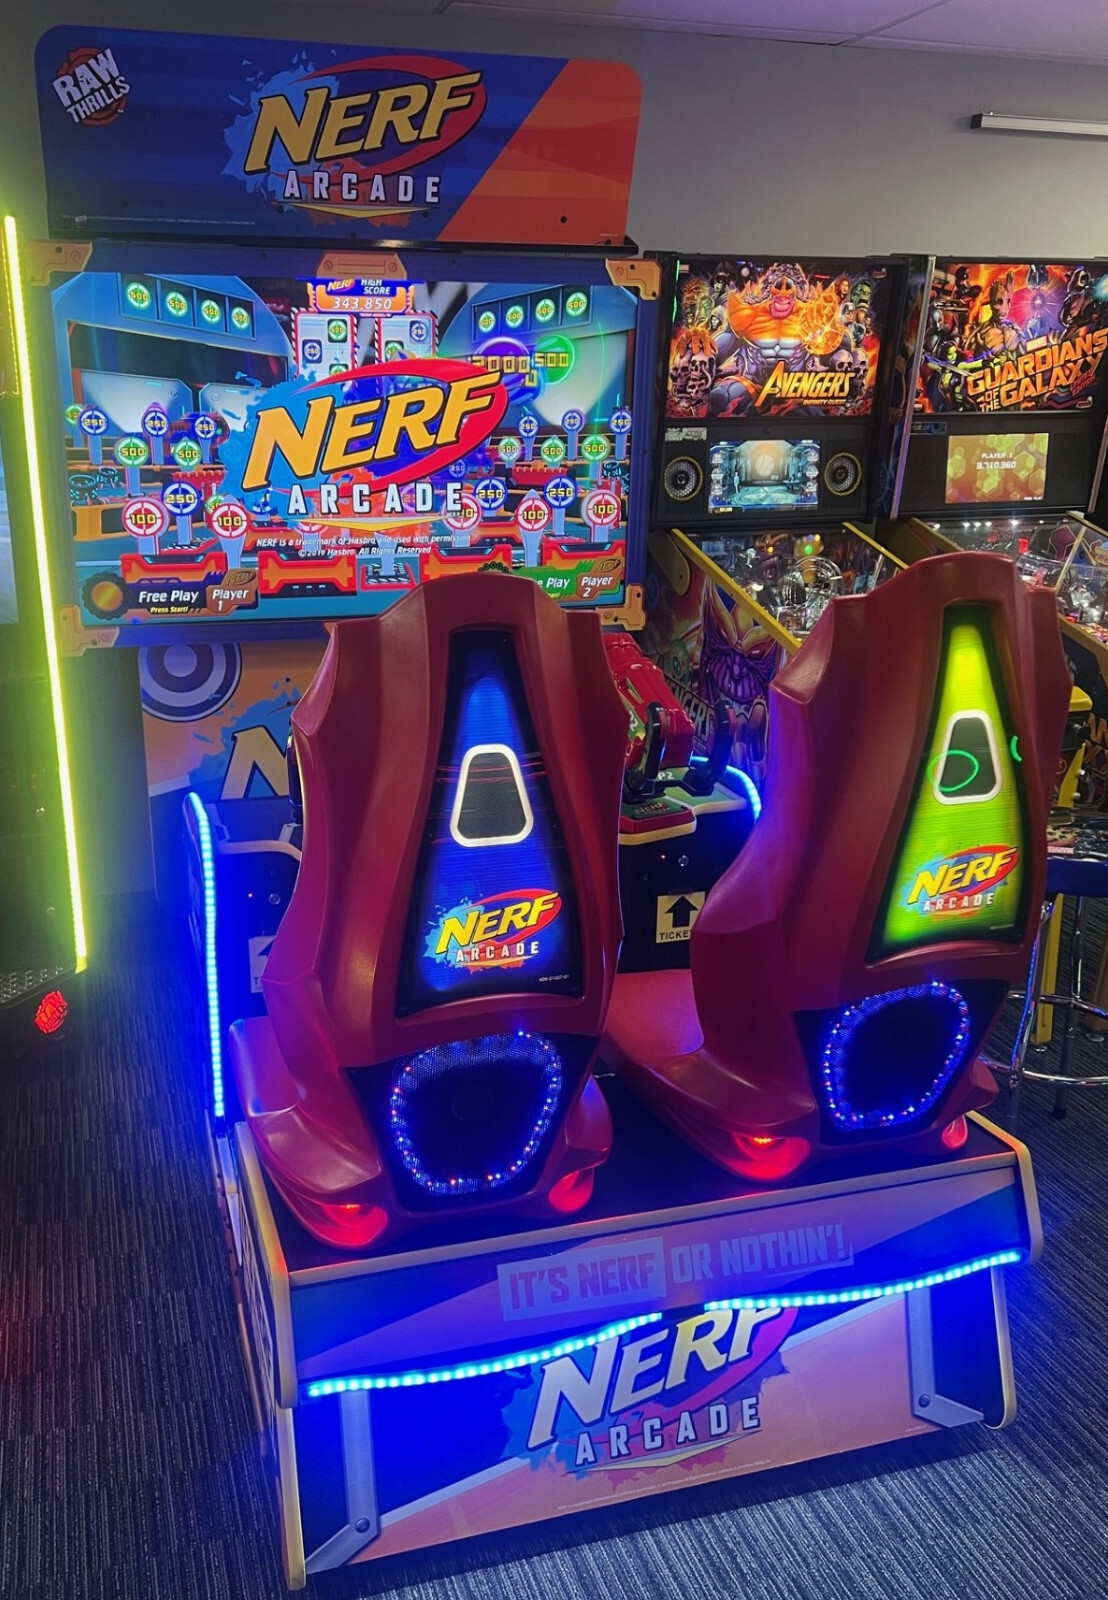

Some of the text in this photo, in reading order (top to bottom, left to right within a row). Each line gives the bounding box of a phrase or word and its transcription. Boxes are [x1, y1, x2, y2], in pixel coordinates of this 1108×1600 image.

[52, 48, 120, 108] RAW
[66, 76, 130, 123] THRILLS
[244, 71, 482, 174] NERF
[284, 171, 440, 204] ARCADE
[360, 279, 382, 287] HIGH
[130, 291, 148, 301] 500
[363, 287, 391, 295] SCORE
[169, 300, 186, 309] 500
[568, 301, 585, 309] 500
[204, 308, 219, 317] 500
[234, 314, 248, 322] 500
[535, 353, 569, 367] 500
[967, 329, 1108, 395] GUARDIANS
[755, 360, 857, 407] AVENGERS
[1000, 352, 1103, 407] GALAXY
[985, 388, 999, 402] OF
[980, 399, 1000, 412] THE
[83, 418, 105, 427] 250
[147, 420, 167, 428] 250
[197, 423, 214, 431] 250
[242, 370, 501, 491] NERF
[121, 448, 146, 457] 500
[500, 445, 518, 453] 500
[543, 447, 562, 456] 500
[585, 444, 605, 453] 500
[178, 450, 199, 458] 500
[478, 489, 503, 499] 250
[549, 487, 573, 497] 250
[165, 494, 195, 504] 250
[287, 482, 463, 514] ARCADE
[593, 504, 614, 514] 100
[130, 513, 157, 524] 100
[522, 510, 545, 520] 100
[218, 516, 242, 526] 100
[256, 539, 277, 547] NERF
[295, 537, 337, 547] trademark
[394, 536, 411, 544] used
[359, 547, 370, 555] All
[371, 547, 395, 556] Rights
[546, 577, 570, 589] Play
[581, 576, 613, 587] Player
[139, 589, 249, 603] Free Play Player
[583, 587, 591, 598] 2
[170, 606, 189, 614] Start!
[217, 601, 223, 611] 1
[657, 771, 675, 780] P2
[906, 846, 1019, 905] NERF
[923, 892, 994, 912] ARCADE
[435, 892, 560, 956] NERF
[659, 930, 691, 941] TICKE
[456, 941, 539, 963] ARCADE
[509, 1224, 845, 1310] IT'S NERF OR NOTHIN'!
[527, 1307, 782, 1449] NERF
[575, 1395, 759, 1467] ARCADE
